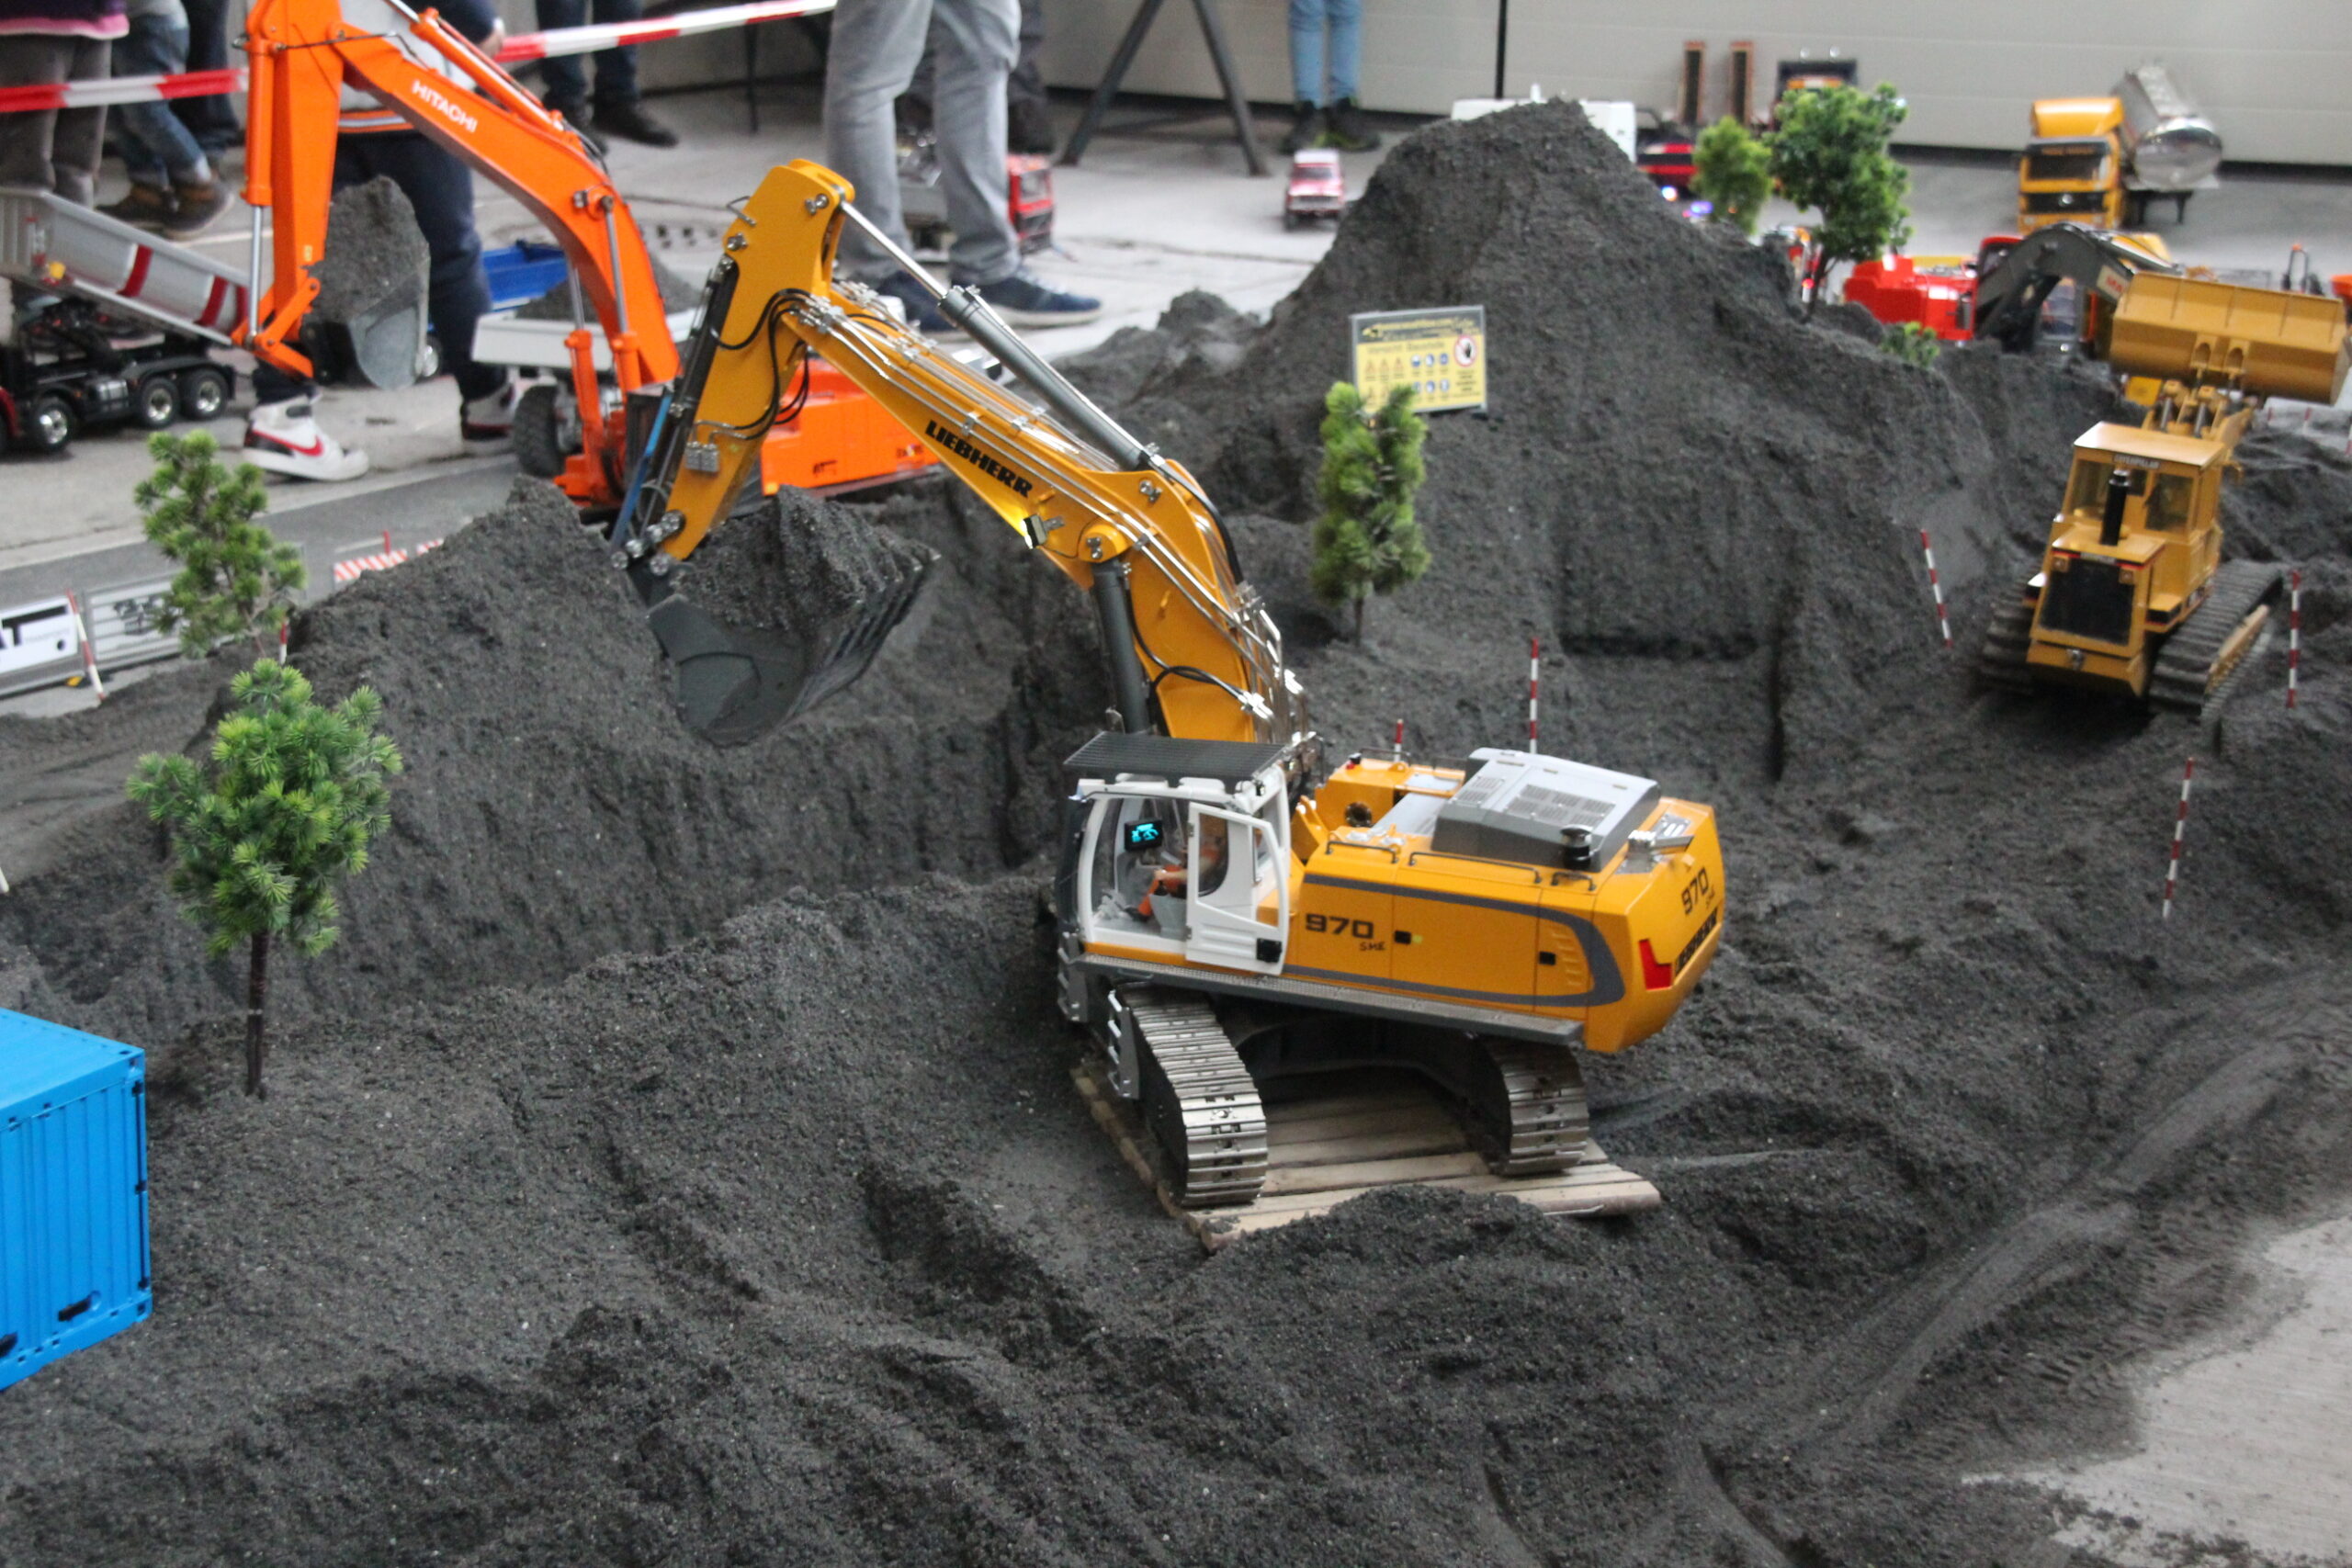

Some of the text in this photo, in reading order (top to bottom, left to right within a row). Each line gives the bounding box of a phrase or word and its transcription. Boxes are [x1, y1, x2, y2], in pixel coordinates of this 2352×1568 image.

[412, 78, 478, 133] HITACHI
[925, 420, 1033, 498] LIEBHERR
[1680, 866, 1709, 916] 970
[1306, 913, 1374, 940] 970
